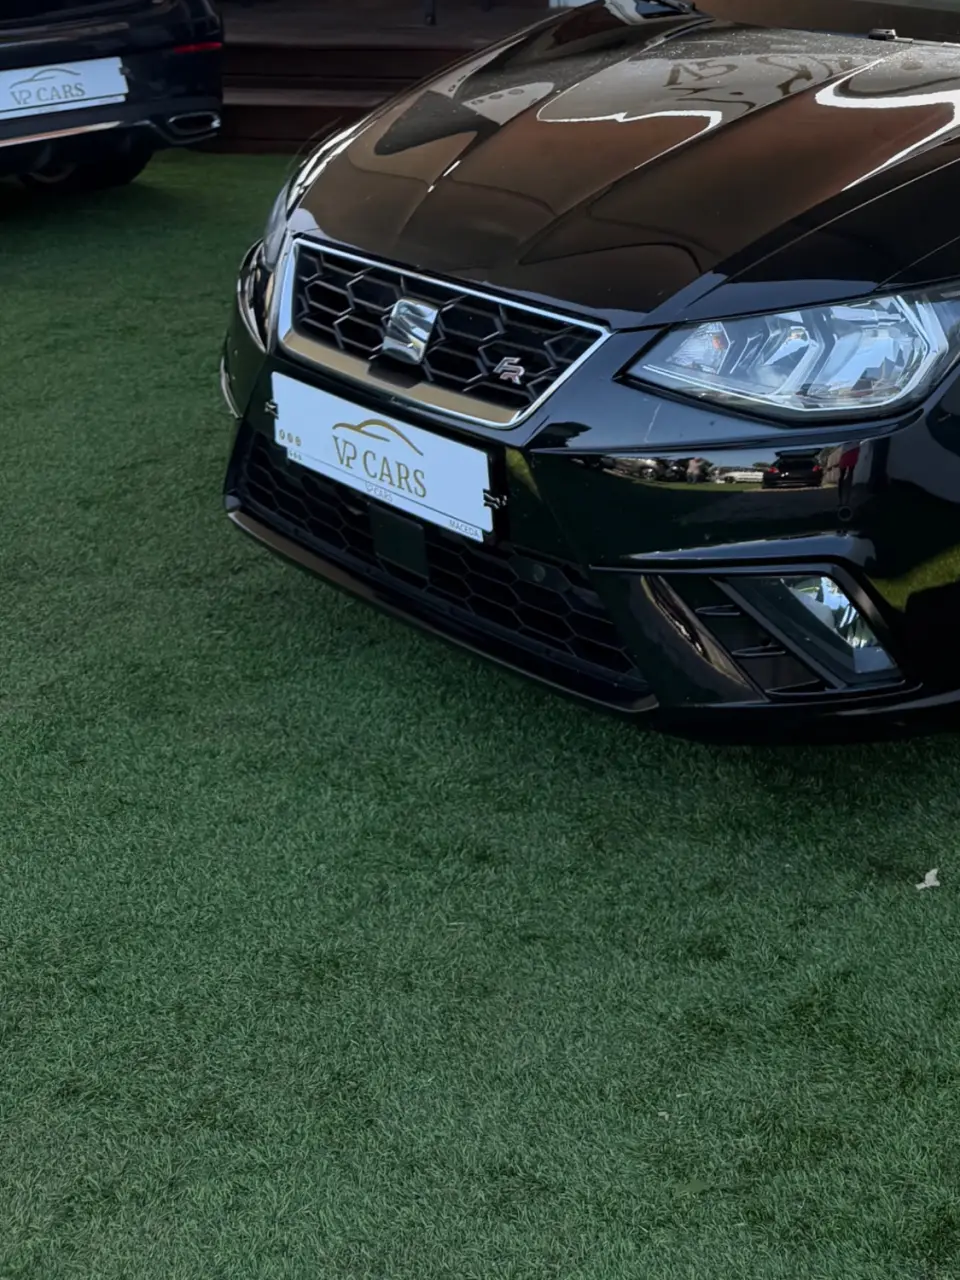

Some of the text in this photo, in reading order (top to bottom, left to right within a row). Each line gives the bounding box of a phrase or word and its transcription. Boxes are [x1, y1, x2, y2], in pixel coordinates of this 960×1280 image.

[10, 82, 86, 105] VP CARS
[332, 435, 427, 498] VP CARS
